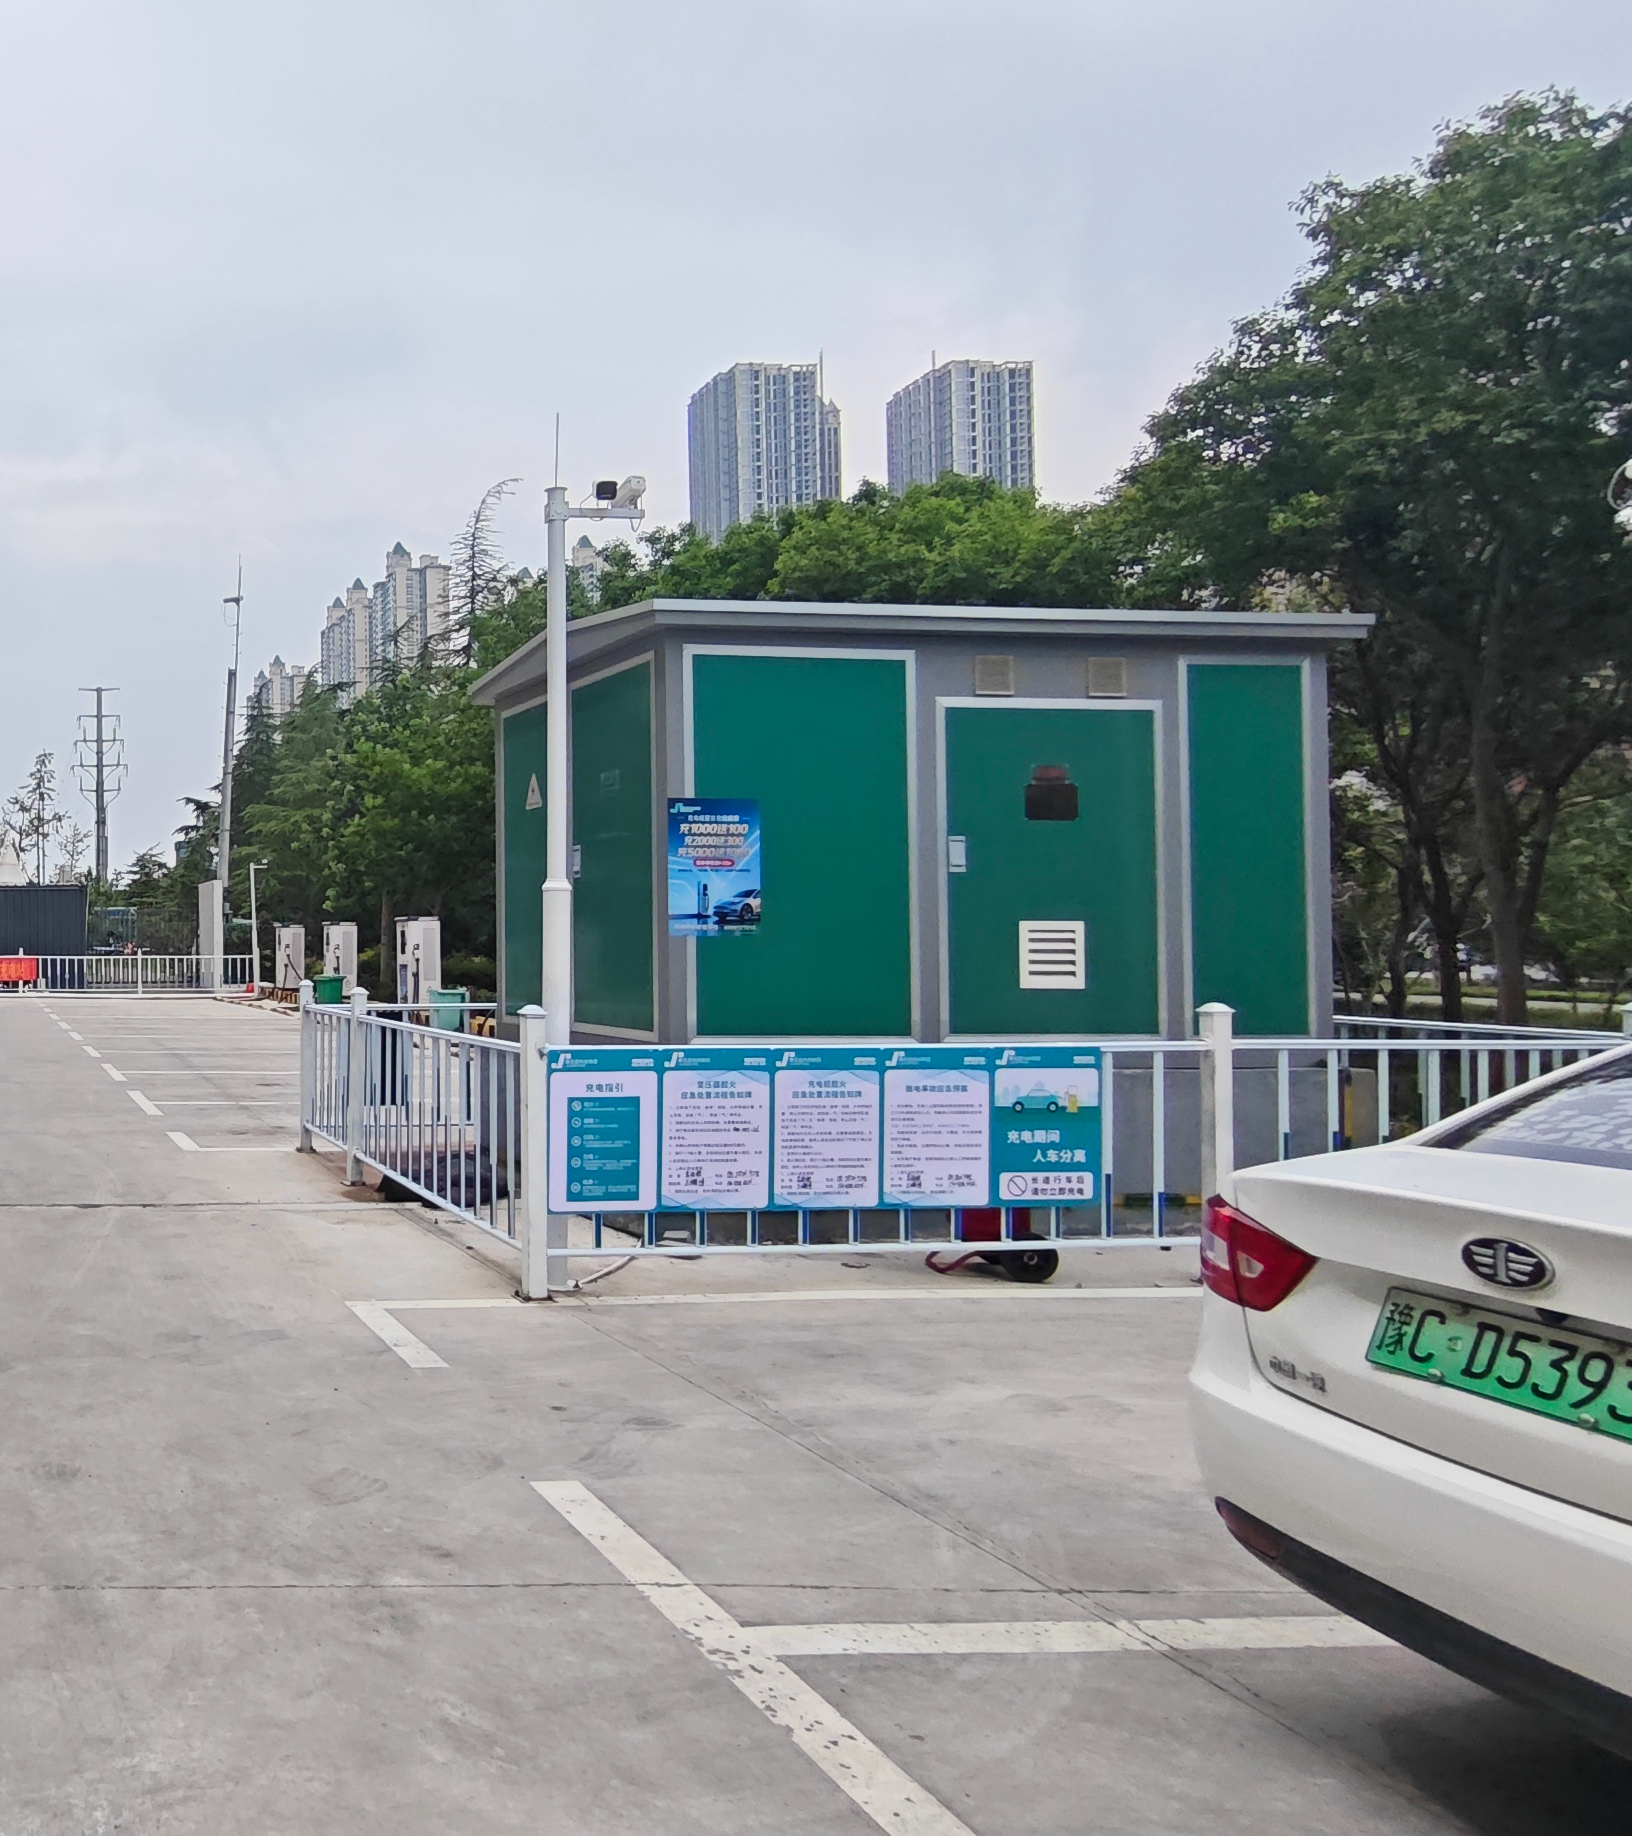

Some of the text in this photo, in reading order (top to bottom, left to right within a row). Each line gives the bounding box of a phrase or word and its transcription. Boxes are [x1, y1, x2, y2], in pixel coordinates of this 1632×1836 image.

[585, 1082, 624, 1093] 充电指引
[1006, 1129, 1061, 1144] 充电期间
[1032, 1148, 1087, 1163] 人车分离
[1030, 1187, 1085, 1197] 请勿立即充电
